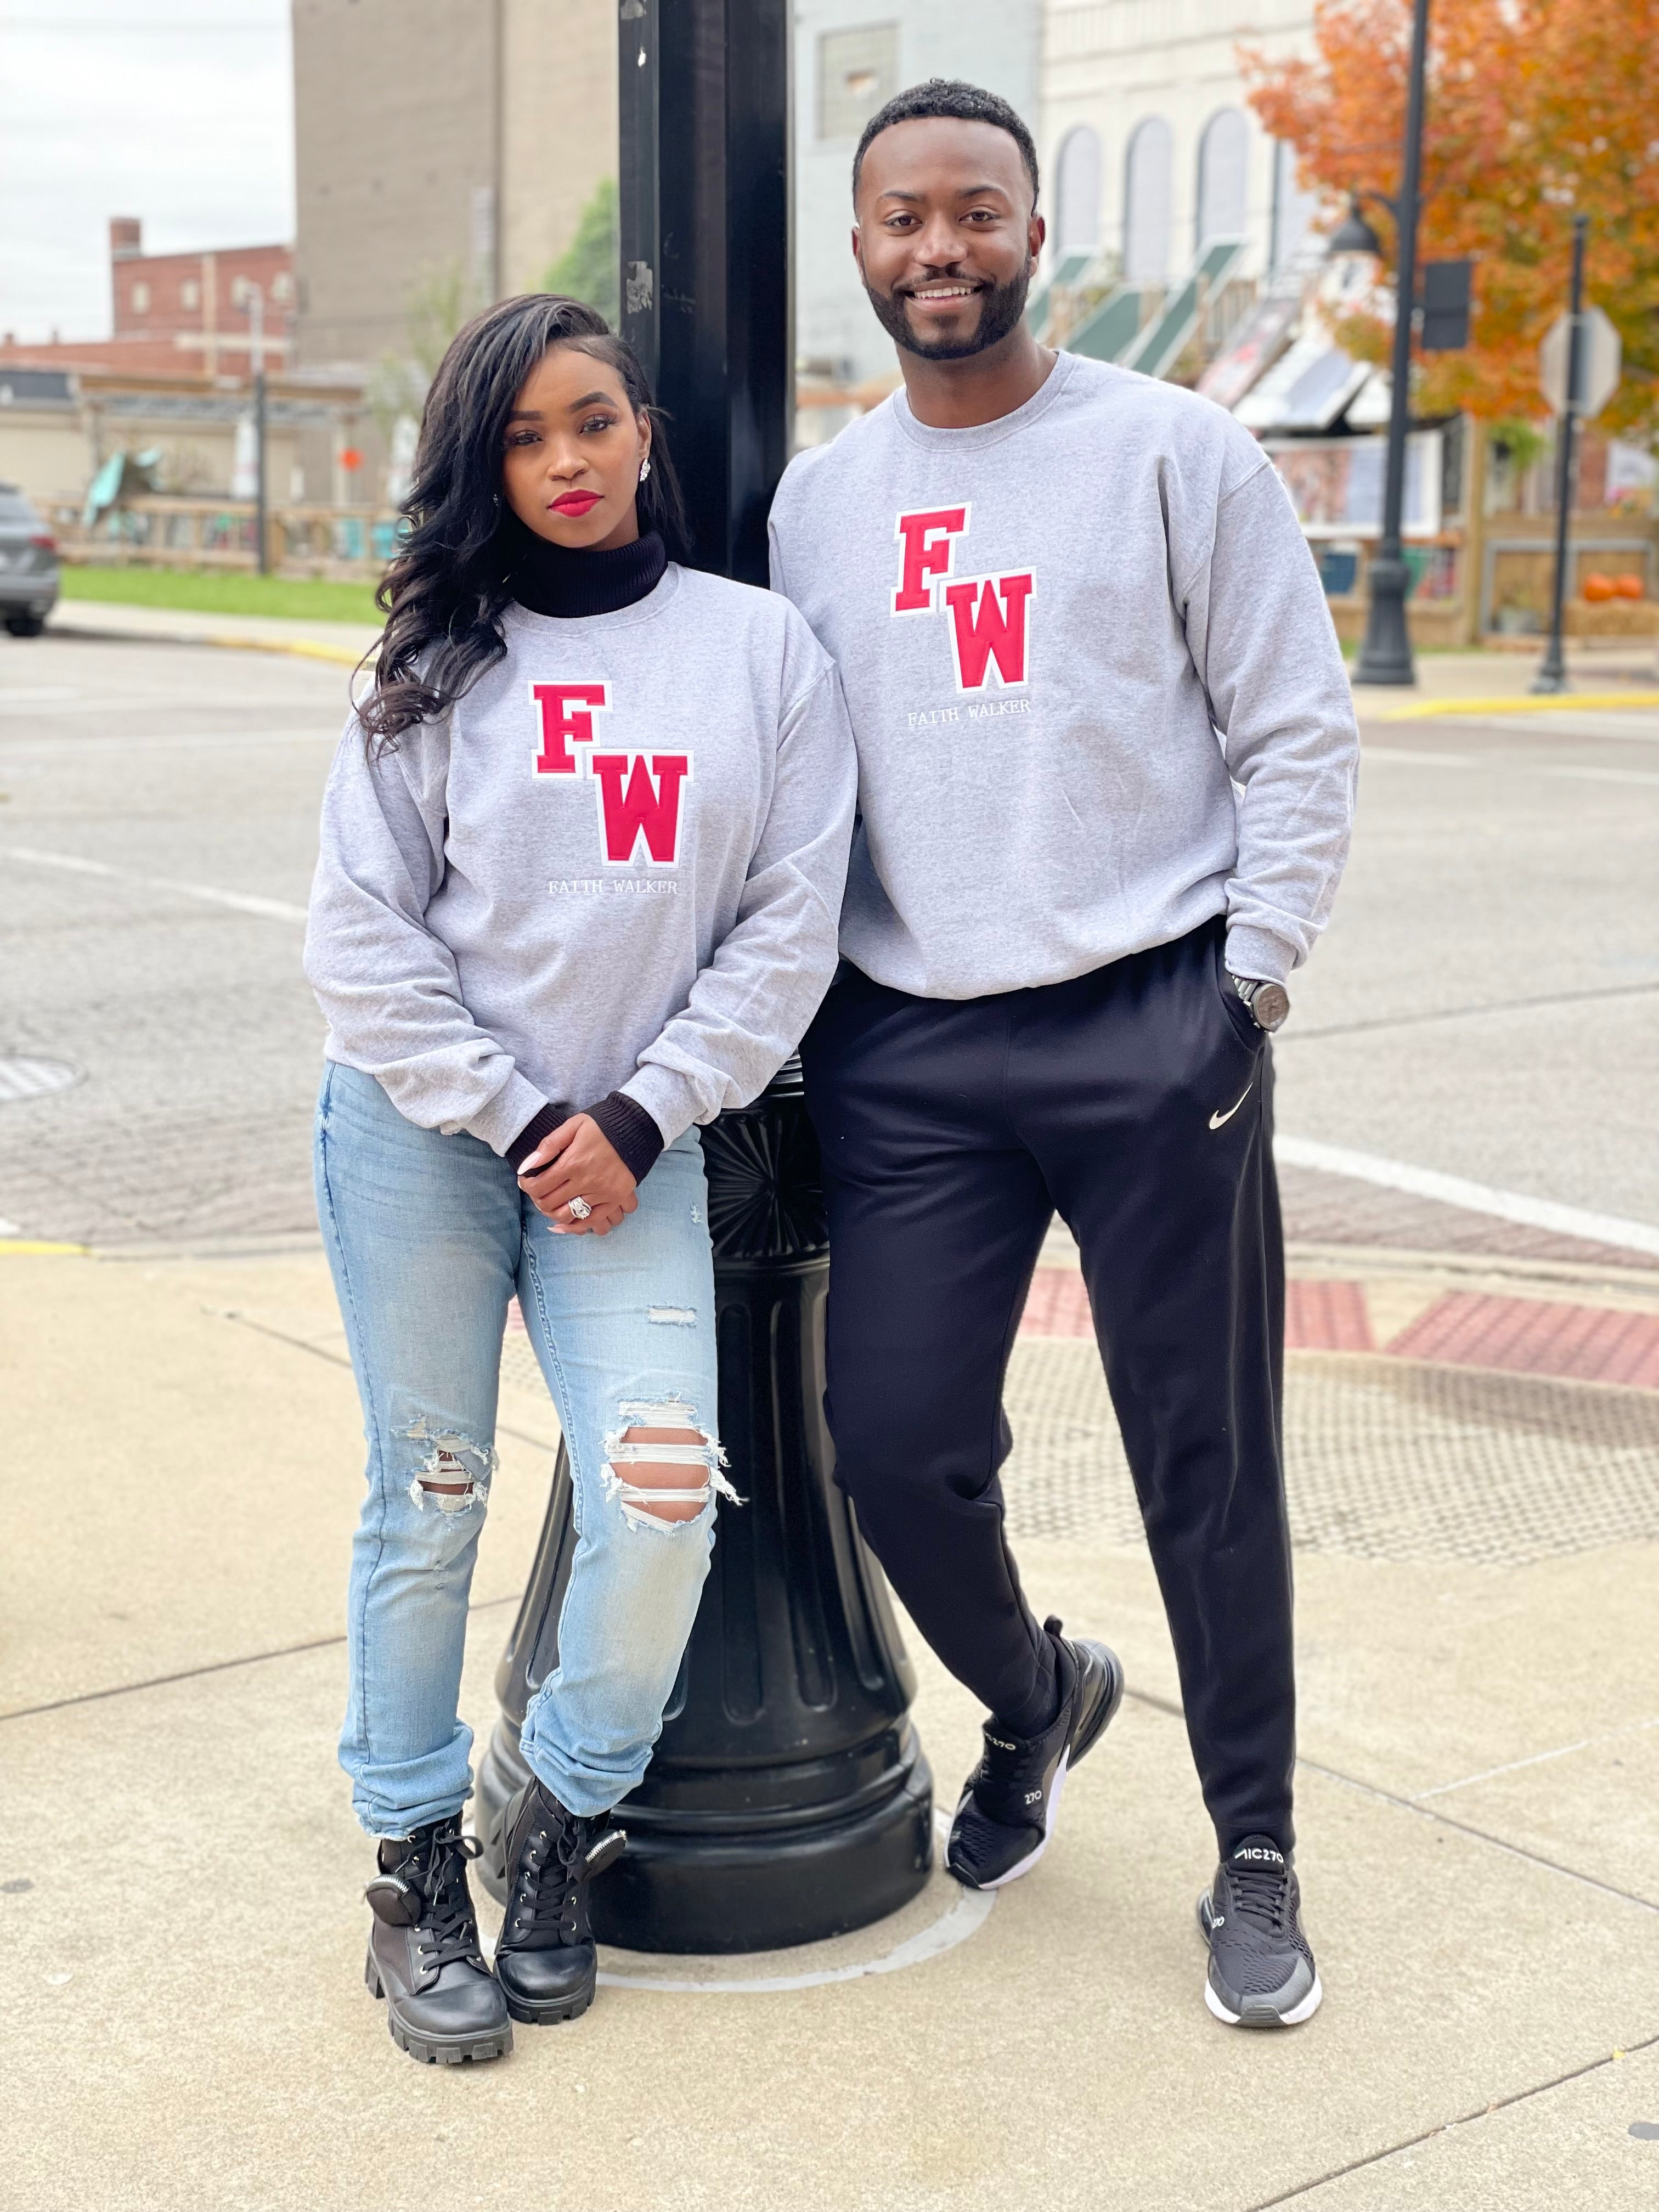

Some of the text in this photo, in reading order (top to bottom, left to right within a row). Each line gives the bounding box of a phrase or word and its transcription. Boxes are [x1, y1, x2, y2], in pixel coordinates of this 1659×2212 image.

[894, 507, 967, 612] F
[945, 572, 1033, 690] W
[532, 684, 606, 774] F
[907, 699, 1031, 727] FAITH WALKER
[592, 754, 689, 863] W
[548, 879, 679, 895] FAITH WALKER
[1024, 1790, 1042, 1804] 270
